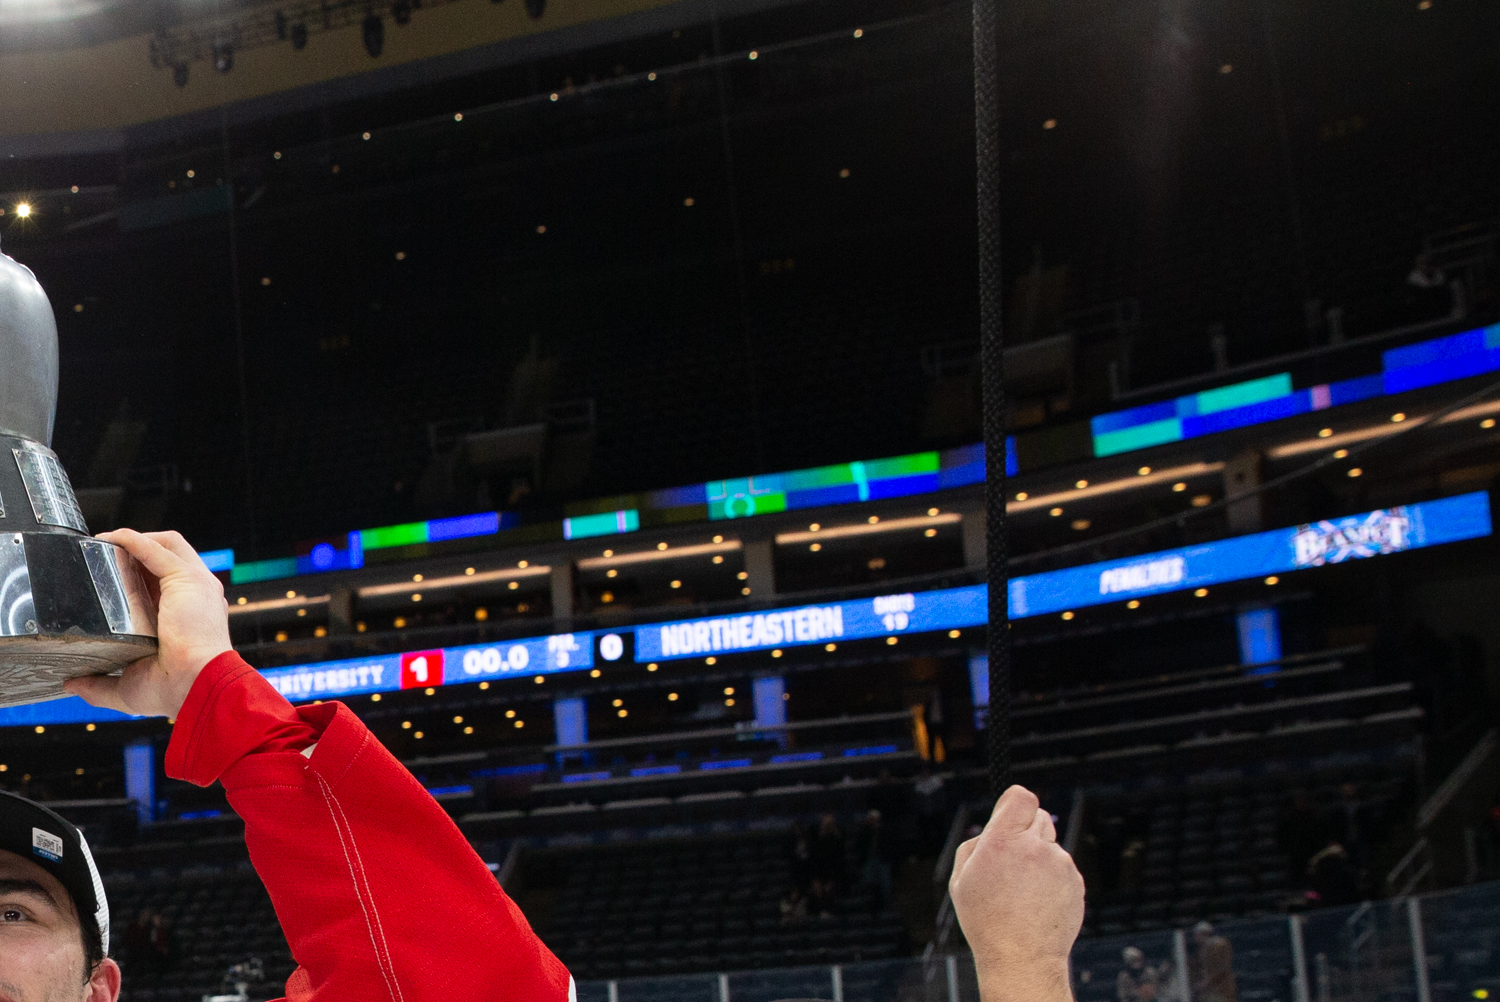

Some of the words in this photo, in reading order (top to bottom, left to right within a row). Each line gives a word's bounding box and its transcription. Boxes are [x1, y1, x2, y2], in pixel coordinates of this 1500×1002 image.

[660, 605, 844, 657] NORTHEASTERN
[463, 645, 529, 675] 00.0
[600, 633, 624, 661] 0
[409, 656, 429, 683] 1
